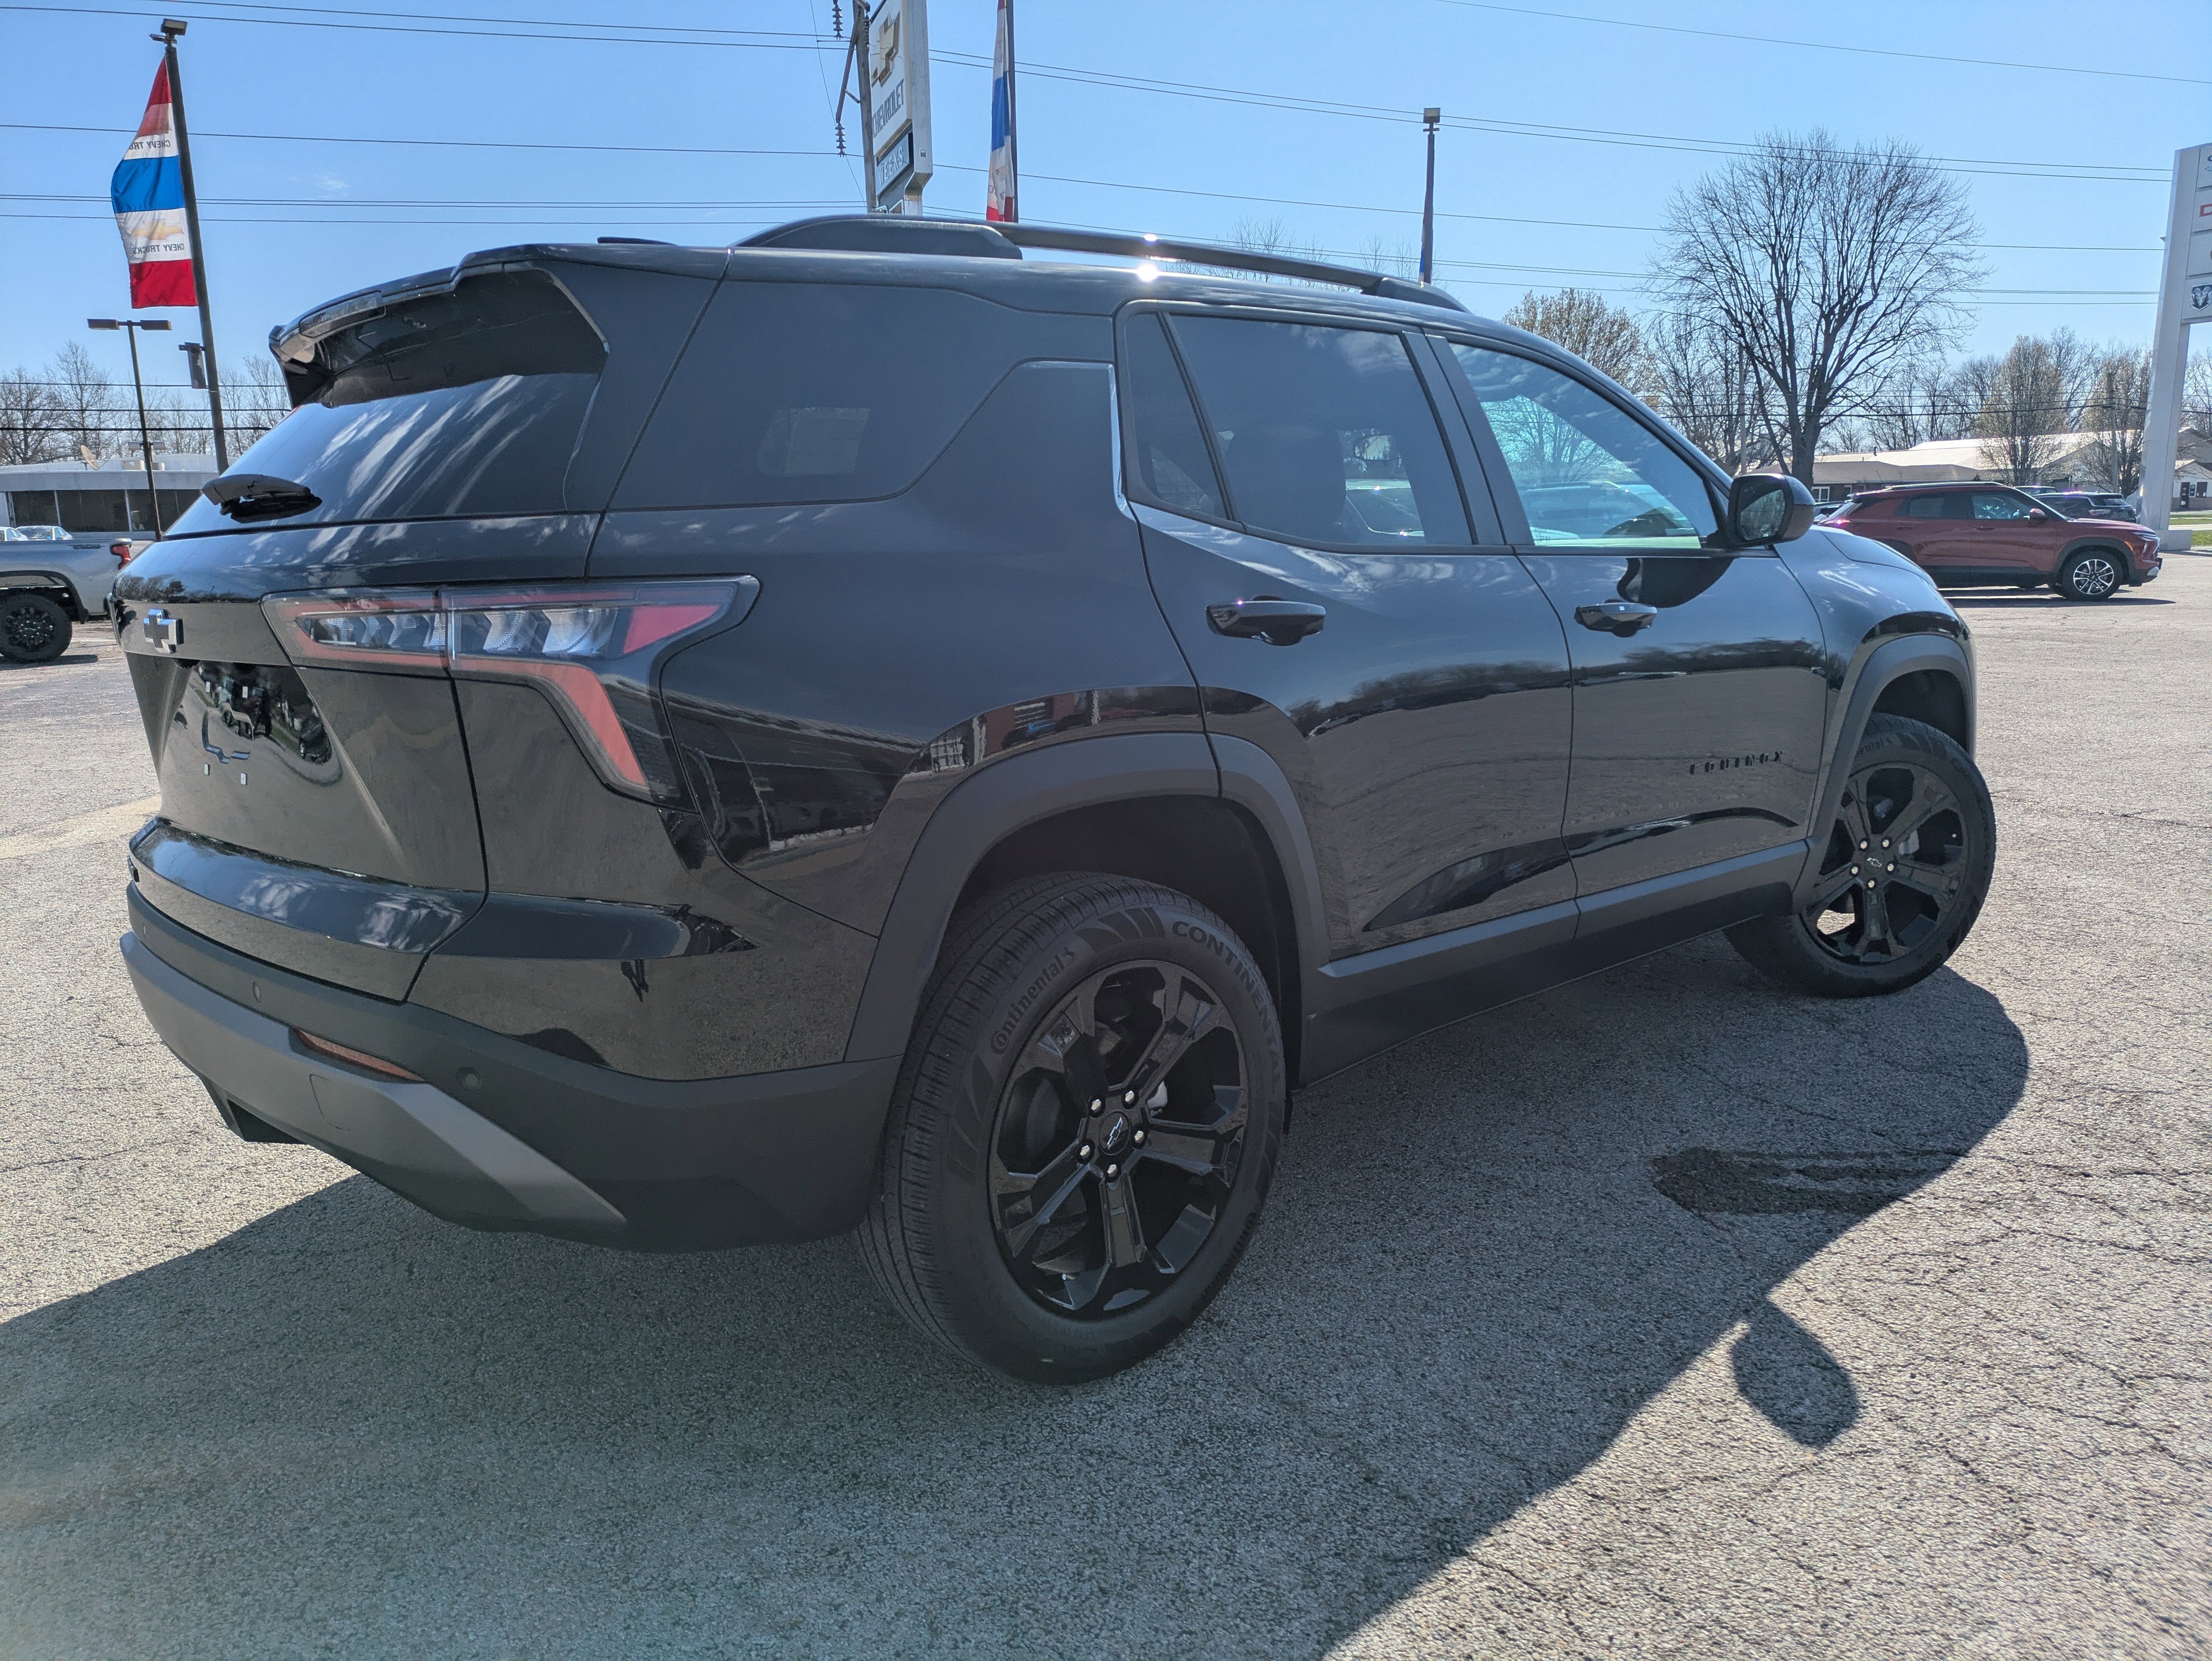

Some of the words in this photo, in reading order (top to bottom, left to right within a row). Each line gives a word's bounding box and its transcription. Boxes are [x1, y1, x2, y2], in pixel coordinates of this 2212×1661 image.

[872, 78, 904, 139] CHEVROLET
[878, 146, 904, 186] WEEKS
[1689, 751, 1783, 775] EQUINOX
[990, 953, 1065, 1054] Continental
[1172, 920, 1280, 1094] CONTINENTAL
